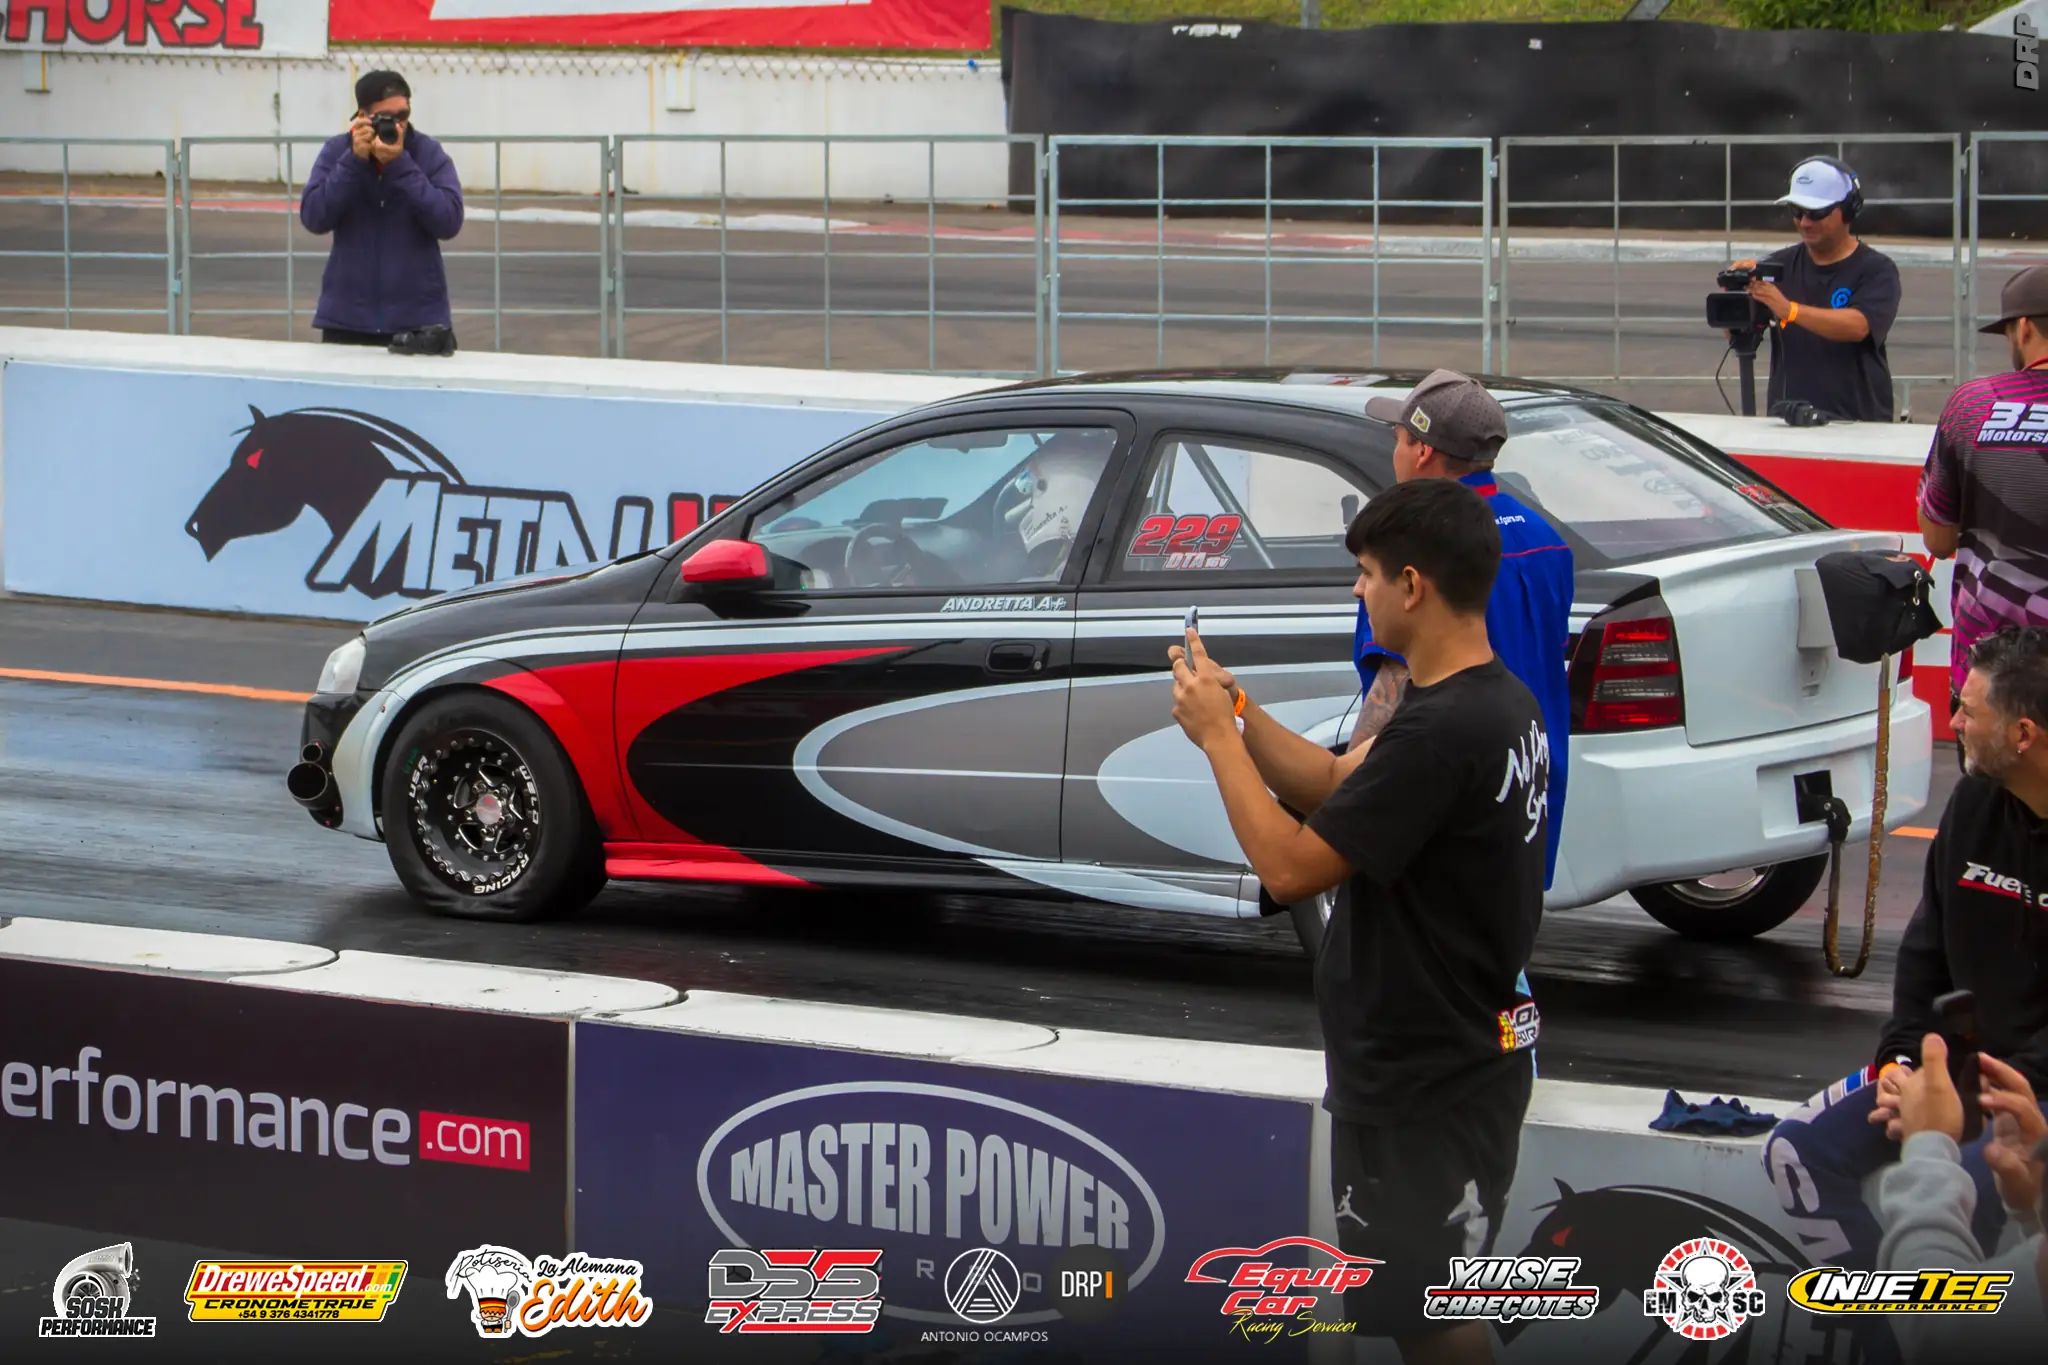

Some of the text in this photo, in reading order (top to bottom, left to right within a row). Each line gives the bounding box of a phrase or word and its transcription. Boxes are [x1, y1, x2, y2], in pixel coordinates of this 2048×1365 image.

[1976, 429, 2048, 444] Motors
[1130, 513, 1242, 555] 229
[939, 596, 1036, 612] ANDRETTA
[519, 765, 539, 825] WELD
[473, 853, 530, 894] RACING
[1, 1046, 522, 1166] erformance .com
[730, 1122, 1130, 1250] MASTER POWER
